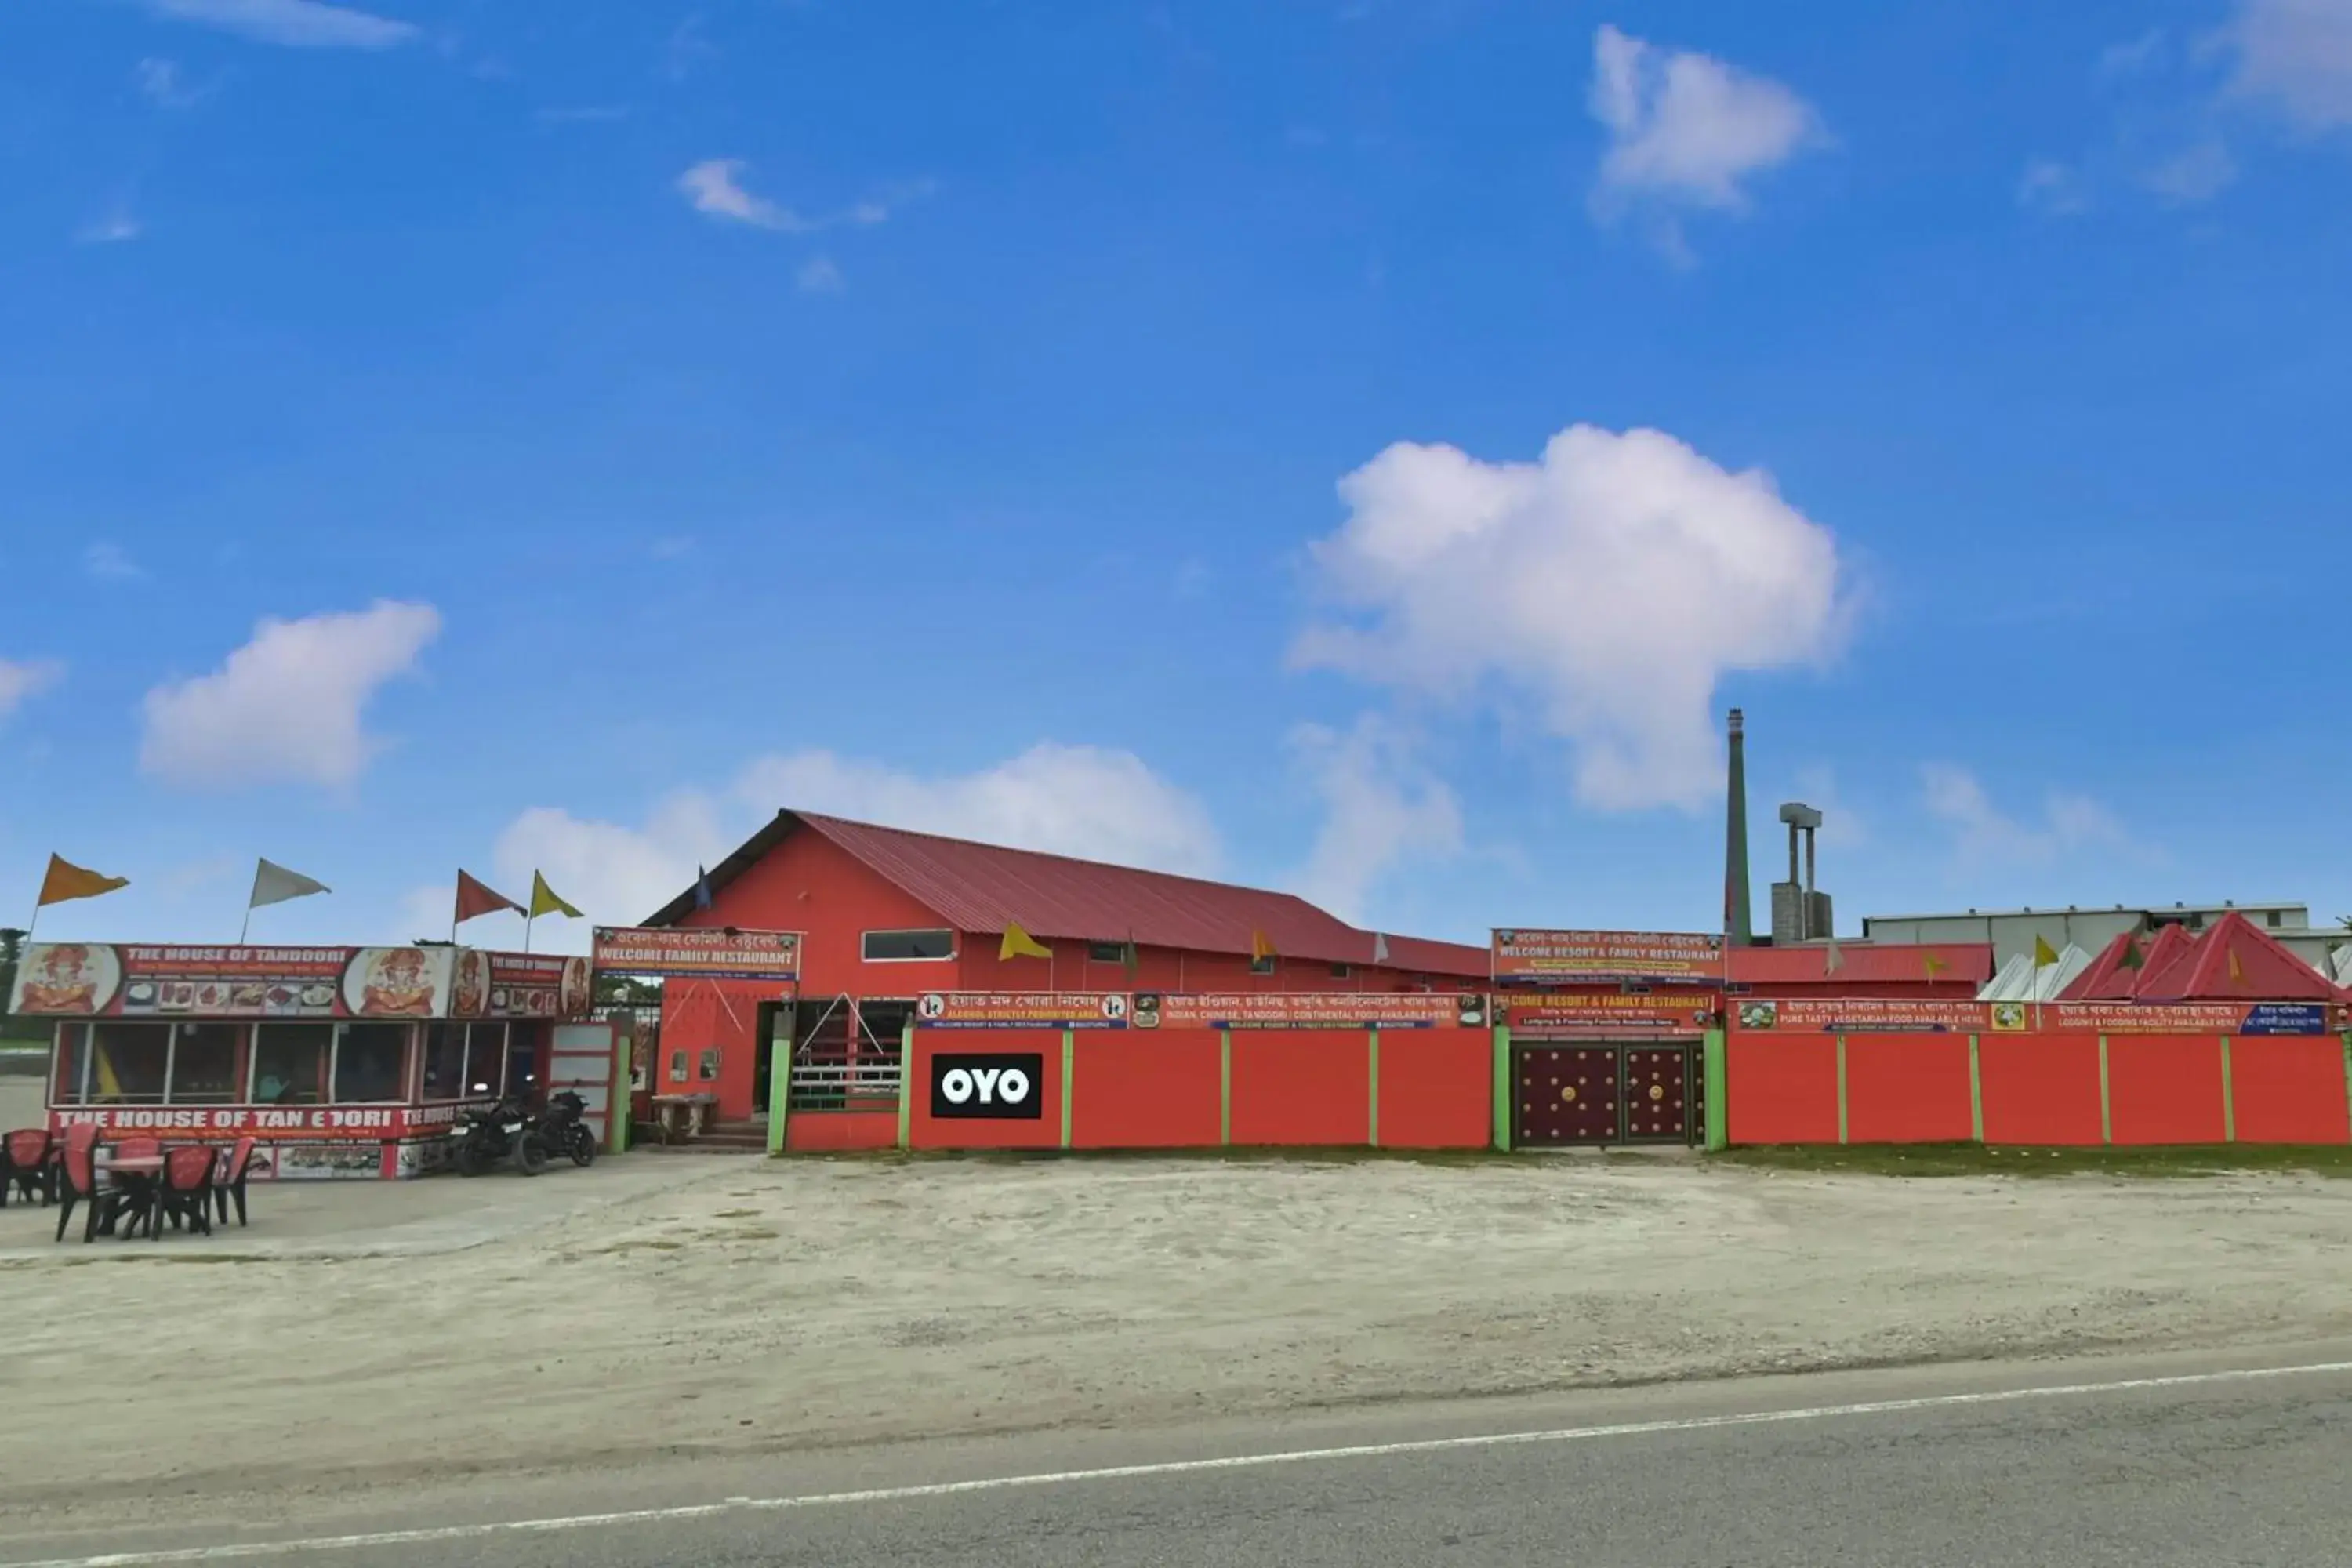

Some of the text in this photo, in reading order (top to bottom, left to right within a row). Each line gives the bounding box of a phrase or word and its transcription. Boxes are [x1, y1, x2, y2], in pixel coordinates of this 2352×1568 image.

[128, 948, 346, 962] THE HOUSE OF TANDOORI
[598, 947, 793, 964] WELCOME FAMILY RESTAURANT
[1500, 946, 1552, 956] WELCOME
[1554, 947, 1595, 957] RESORT
[1608, 947, 1646, 958] FAMILY
[1650, 949, 1719, 960] RESTAURANT
[1545, 995, 1588, 1007] RESORT
[1602, 996, 1640, 1007] FAMILY
[1642, 996, 1709, 1008] RESTAURANT
[942, 1069, 1029, 1104] OYO
[114, 1110, 207, 1127] HOUSE
[213, 1111, 249, 1127] OF
